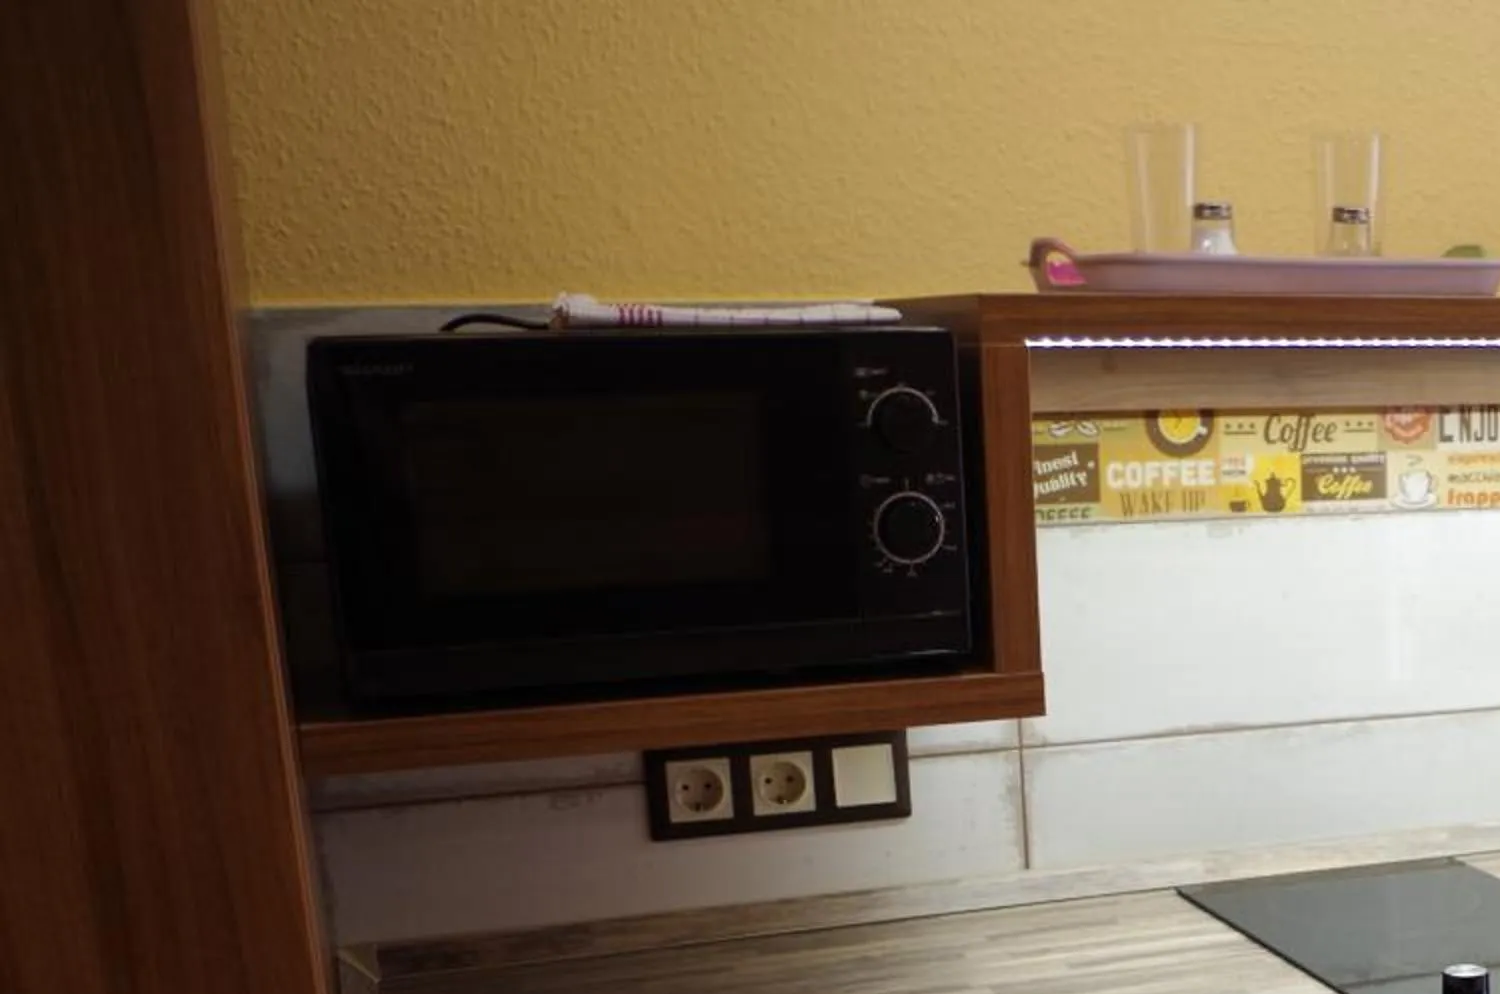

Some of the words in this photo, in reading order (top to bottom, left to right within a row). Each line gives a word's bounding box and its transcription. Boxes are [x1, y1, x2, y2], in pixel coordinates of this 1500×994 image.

[1263, 411, 1338, 453] Coffee
[1032, 450, 1078, 475] inest
[1106, 460, 1216, 489] COFFEE
